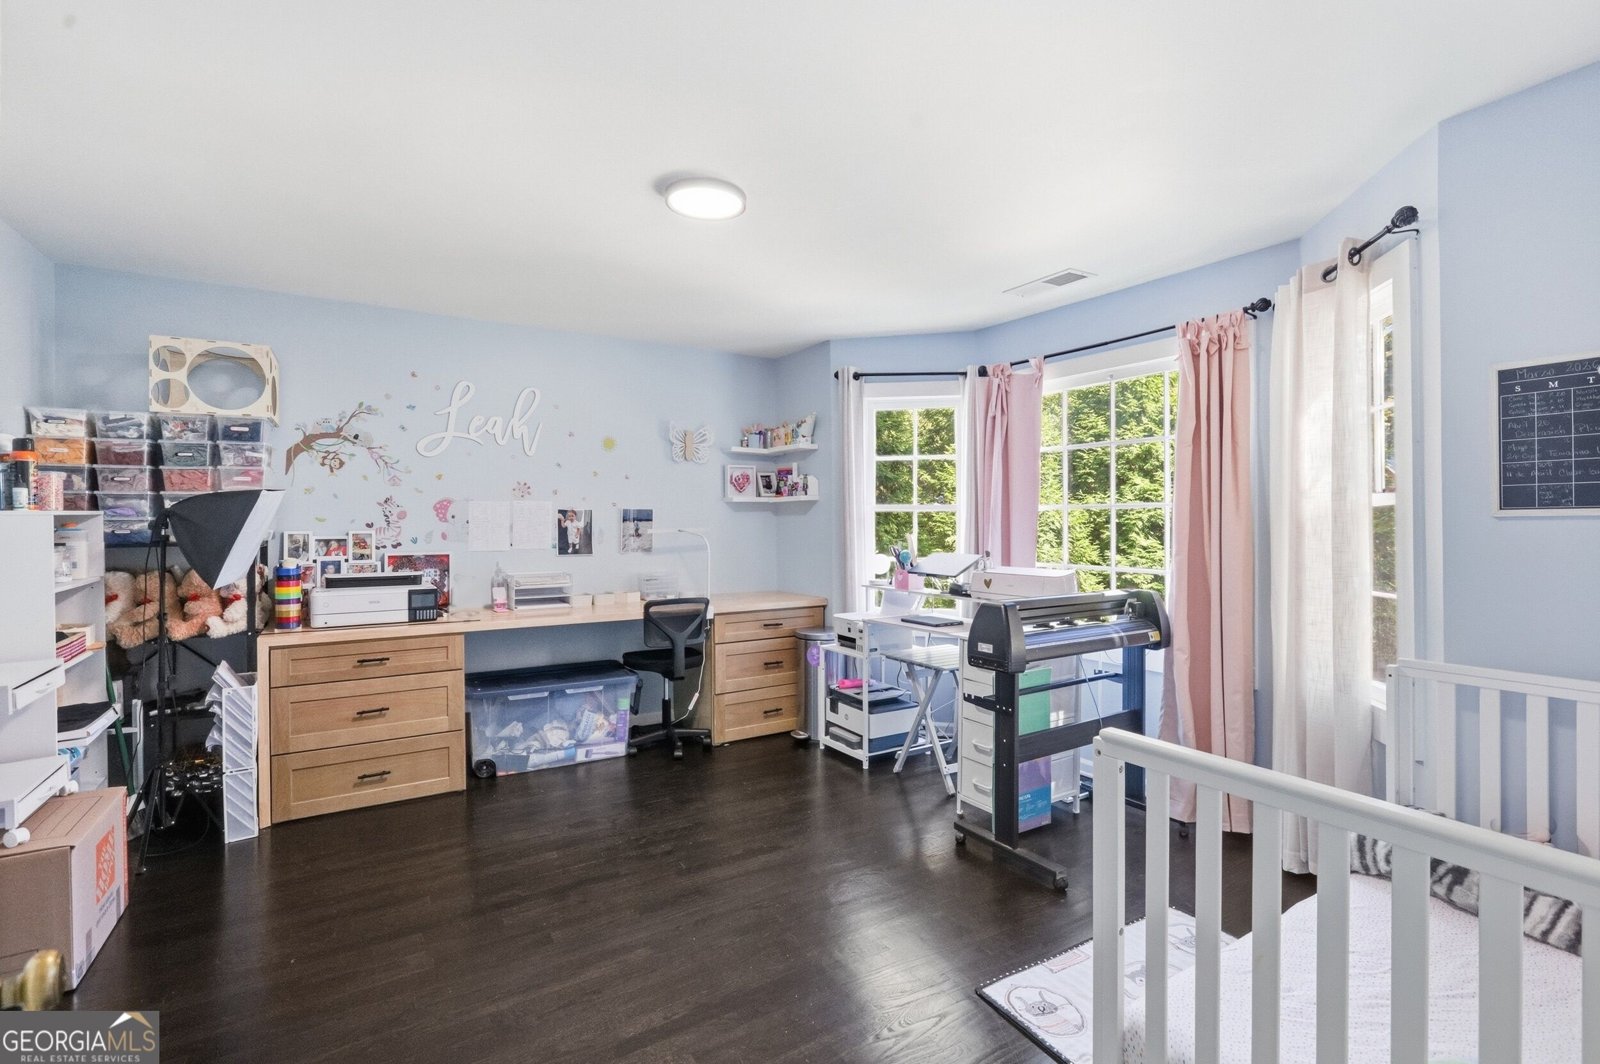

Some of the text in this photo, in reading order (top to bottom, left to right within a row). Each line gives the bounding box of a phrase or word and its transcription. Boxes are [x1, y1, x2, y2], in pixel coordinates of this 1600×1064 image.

[1548, 380, 1559, 388] M
[1586, 376, 1596, 384] T
[416, 380, 542, 457] Leah
